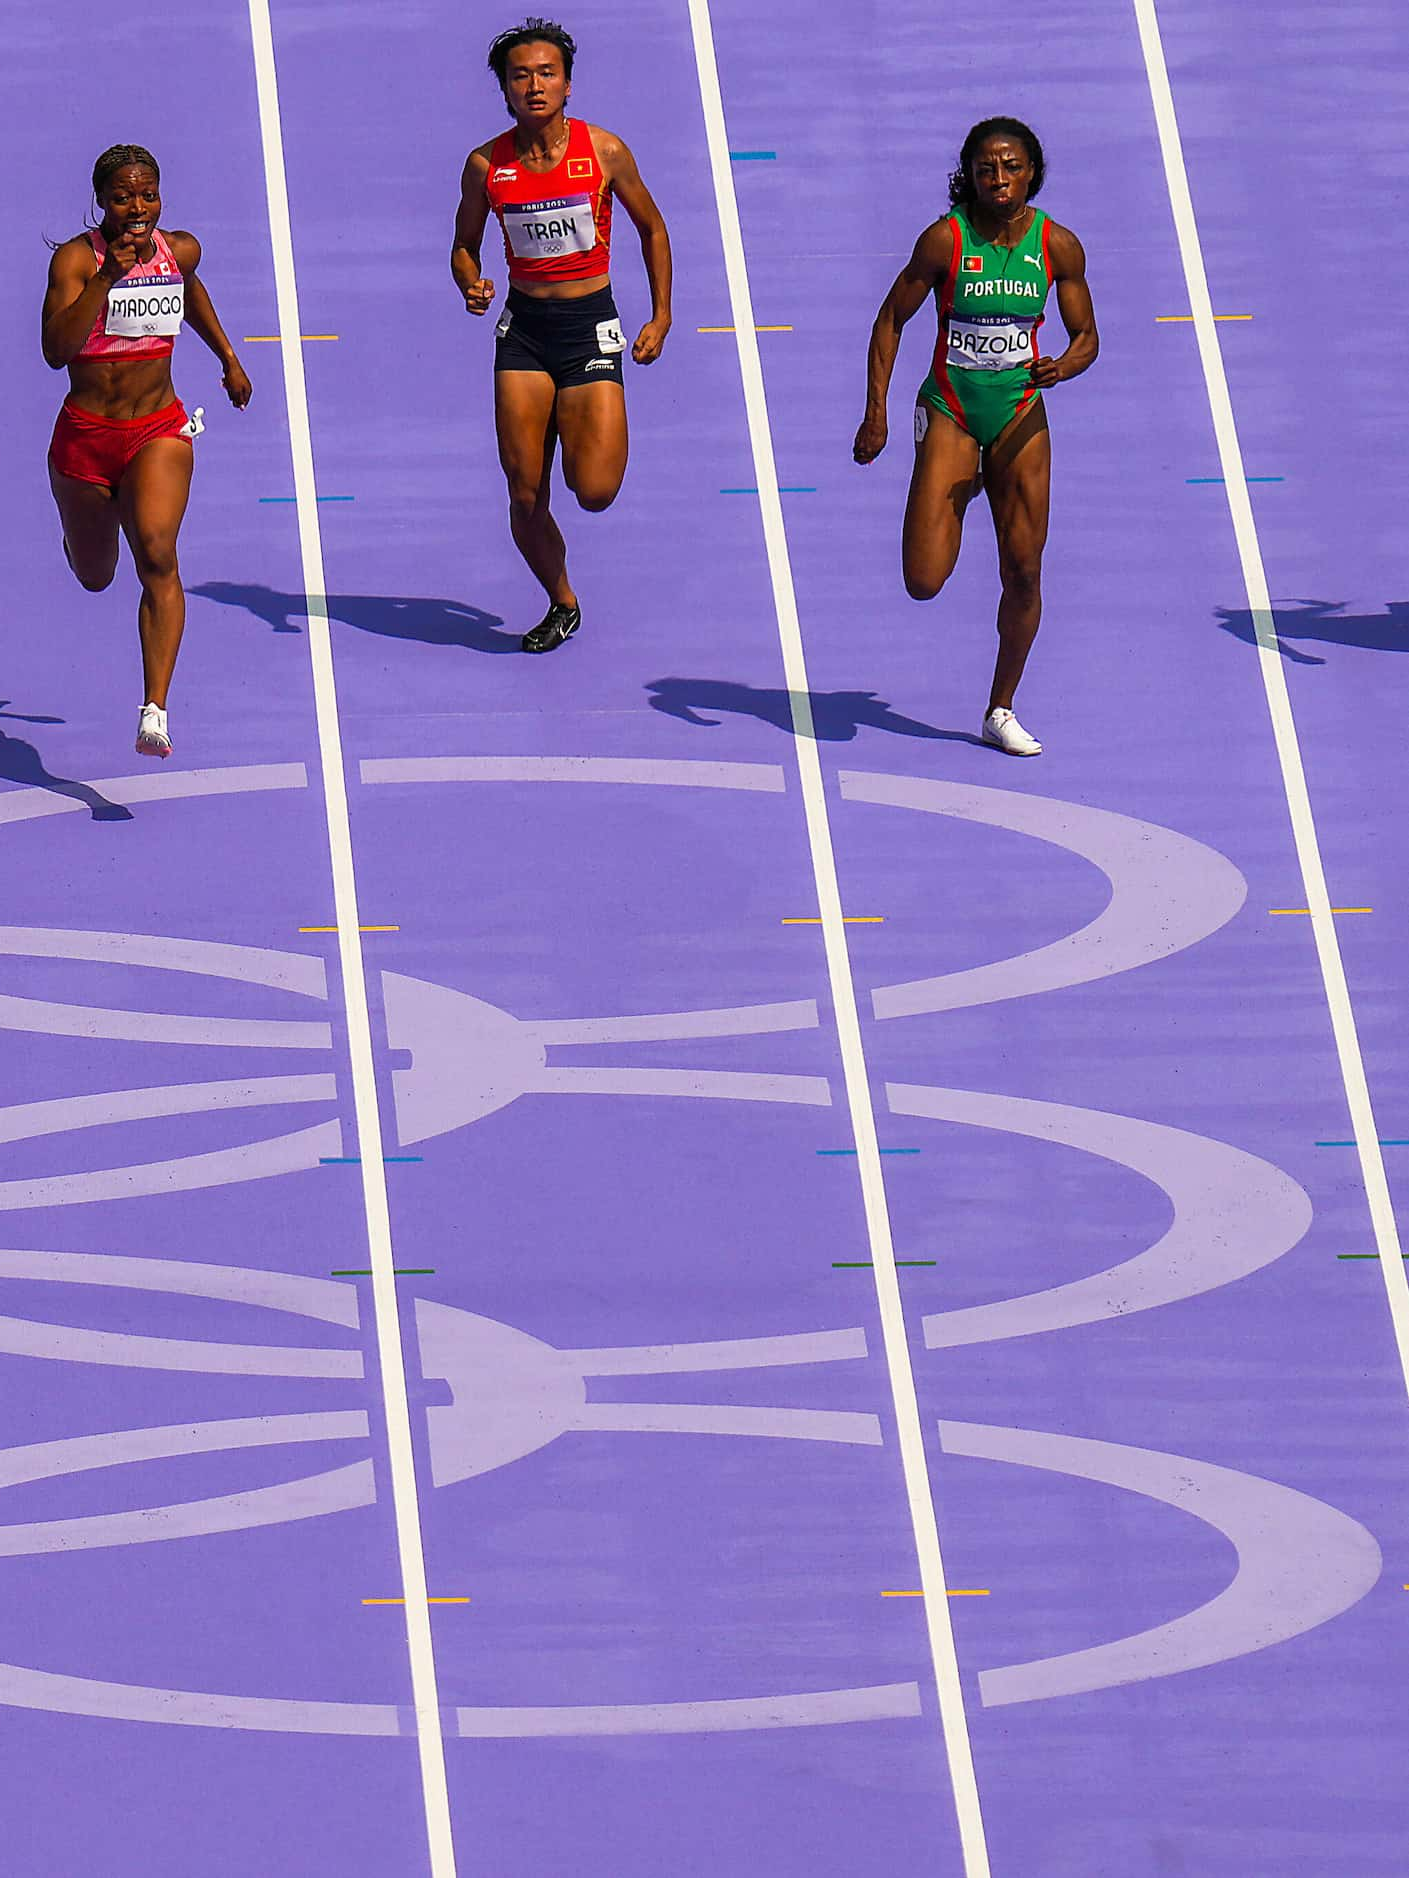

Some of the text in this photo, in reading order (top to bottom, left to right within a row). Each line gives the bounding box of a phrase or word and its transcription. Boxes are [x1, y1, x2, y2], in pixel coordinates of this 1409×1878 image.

[521, 199, 567, 212] PARIS 2024
[522, 216, 577, 241] TRAN
[964, 279, 1040, 298] PORTUGAL
[112, 295, 181, 318] MADOGO
[607, 328, 620, 345] 4
[950, 329, 1029, 354] BAZOLO
